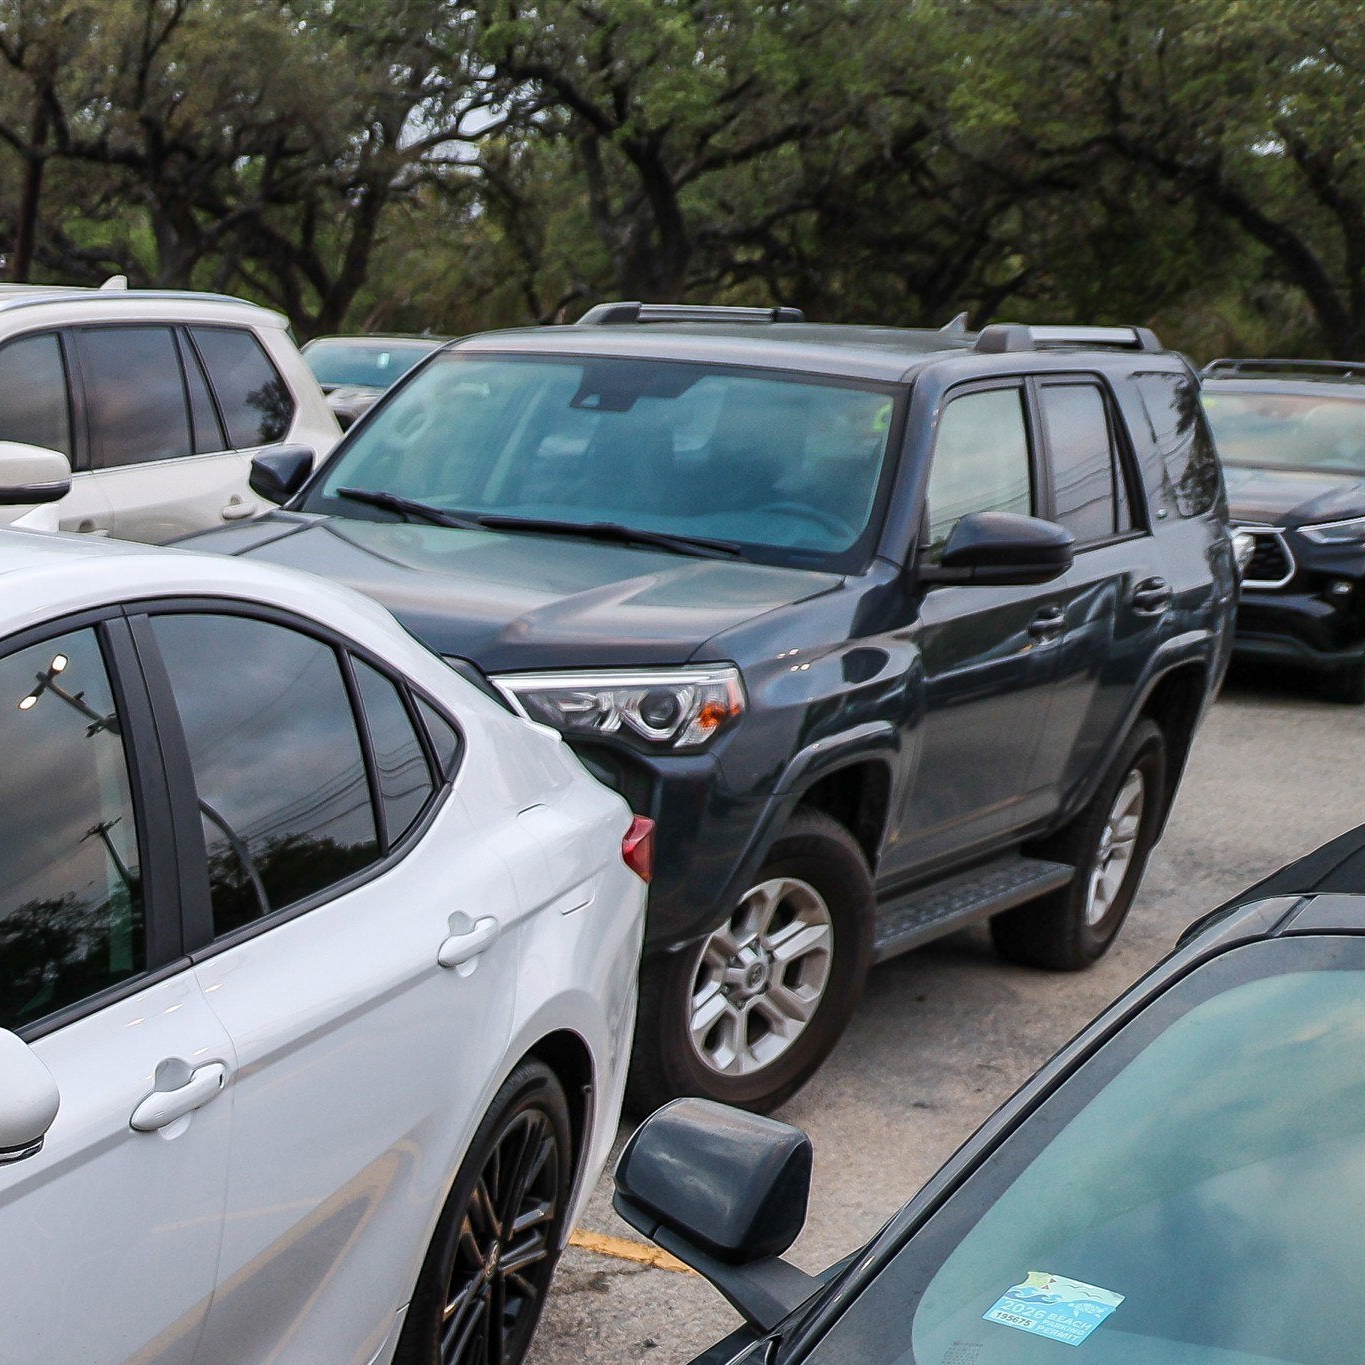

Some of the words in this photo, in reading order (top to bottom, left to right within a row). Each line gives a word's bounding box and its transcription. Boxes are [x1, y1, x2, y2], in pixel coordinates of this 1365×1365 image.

[1000, 1300, 1047, 1319] 2026
[995, 1312, 1031, 1326] 195675
[1047, 1313, 1092, 1331] BEACH
[1036, 1325, 1080, 1341] PERMIT
[1042, 1320, 1087, 1335] PARKING
